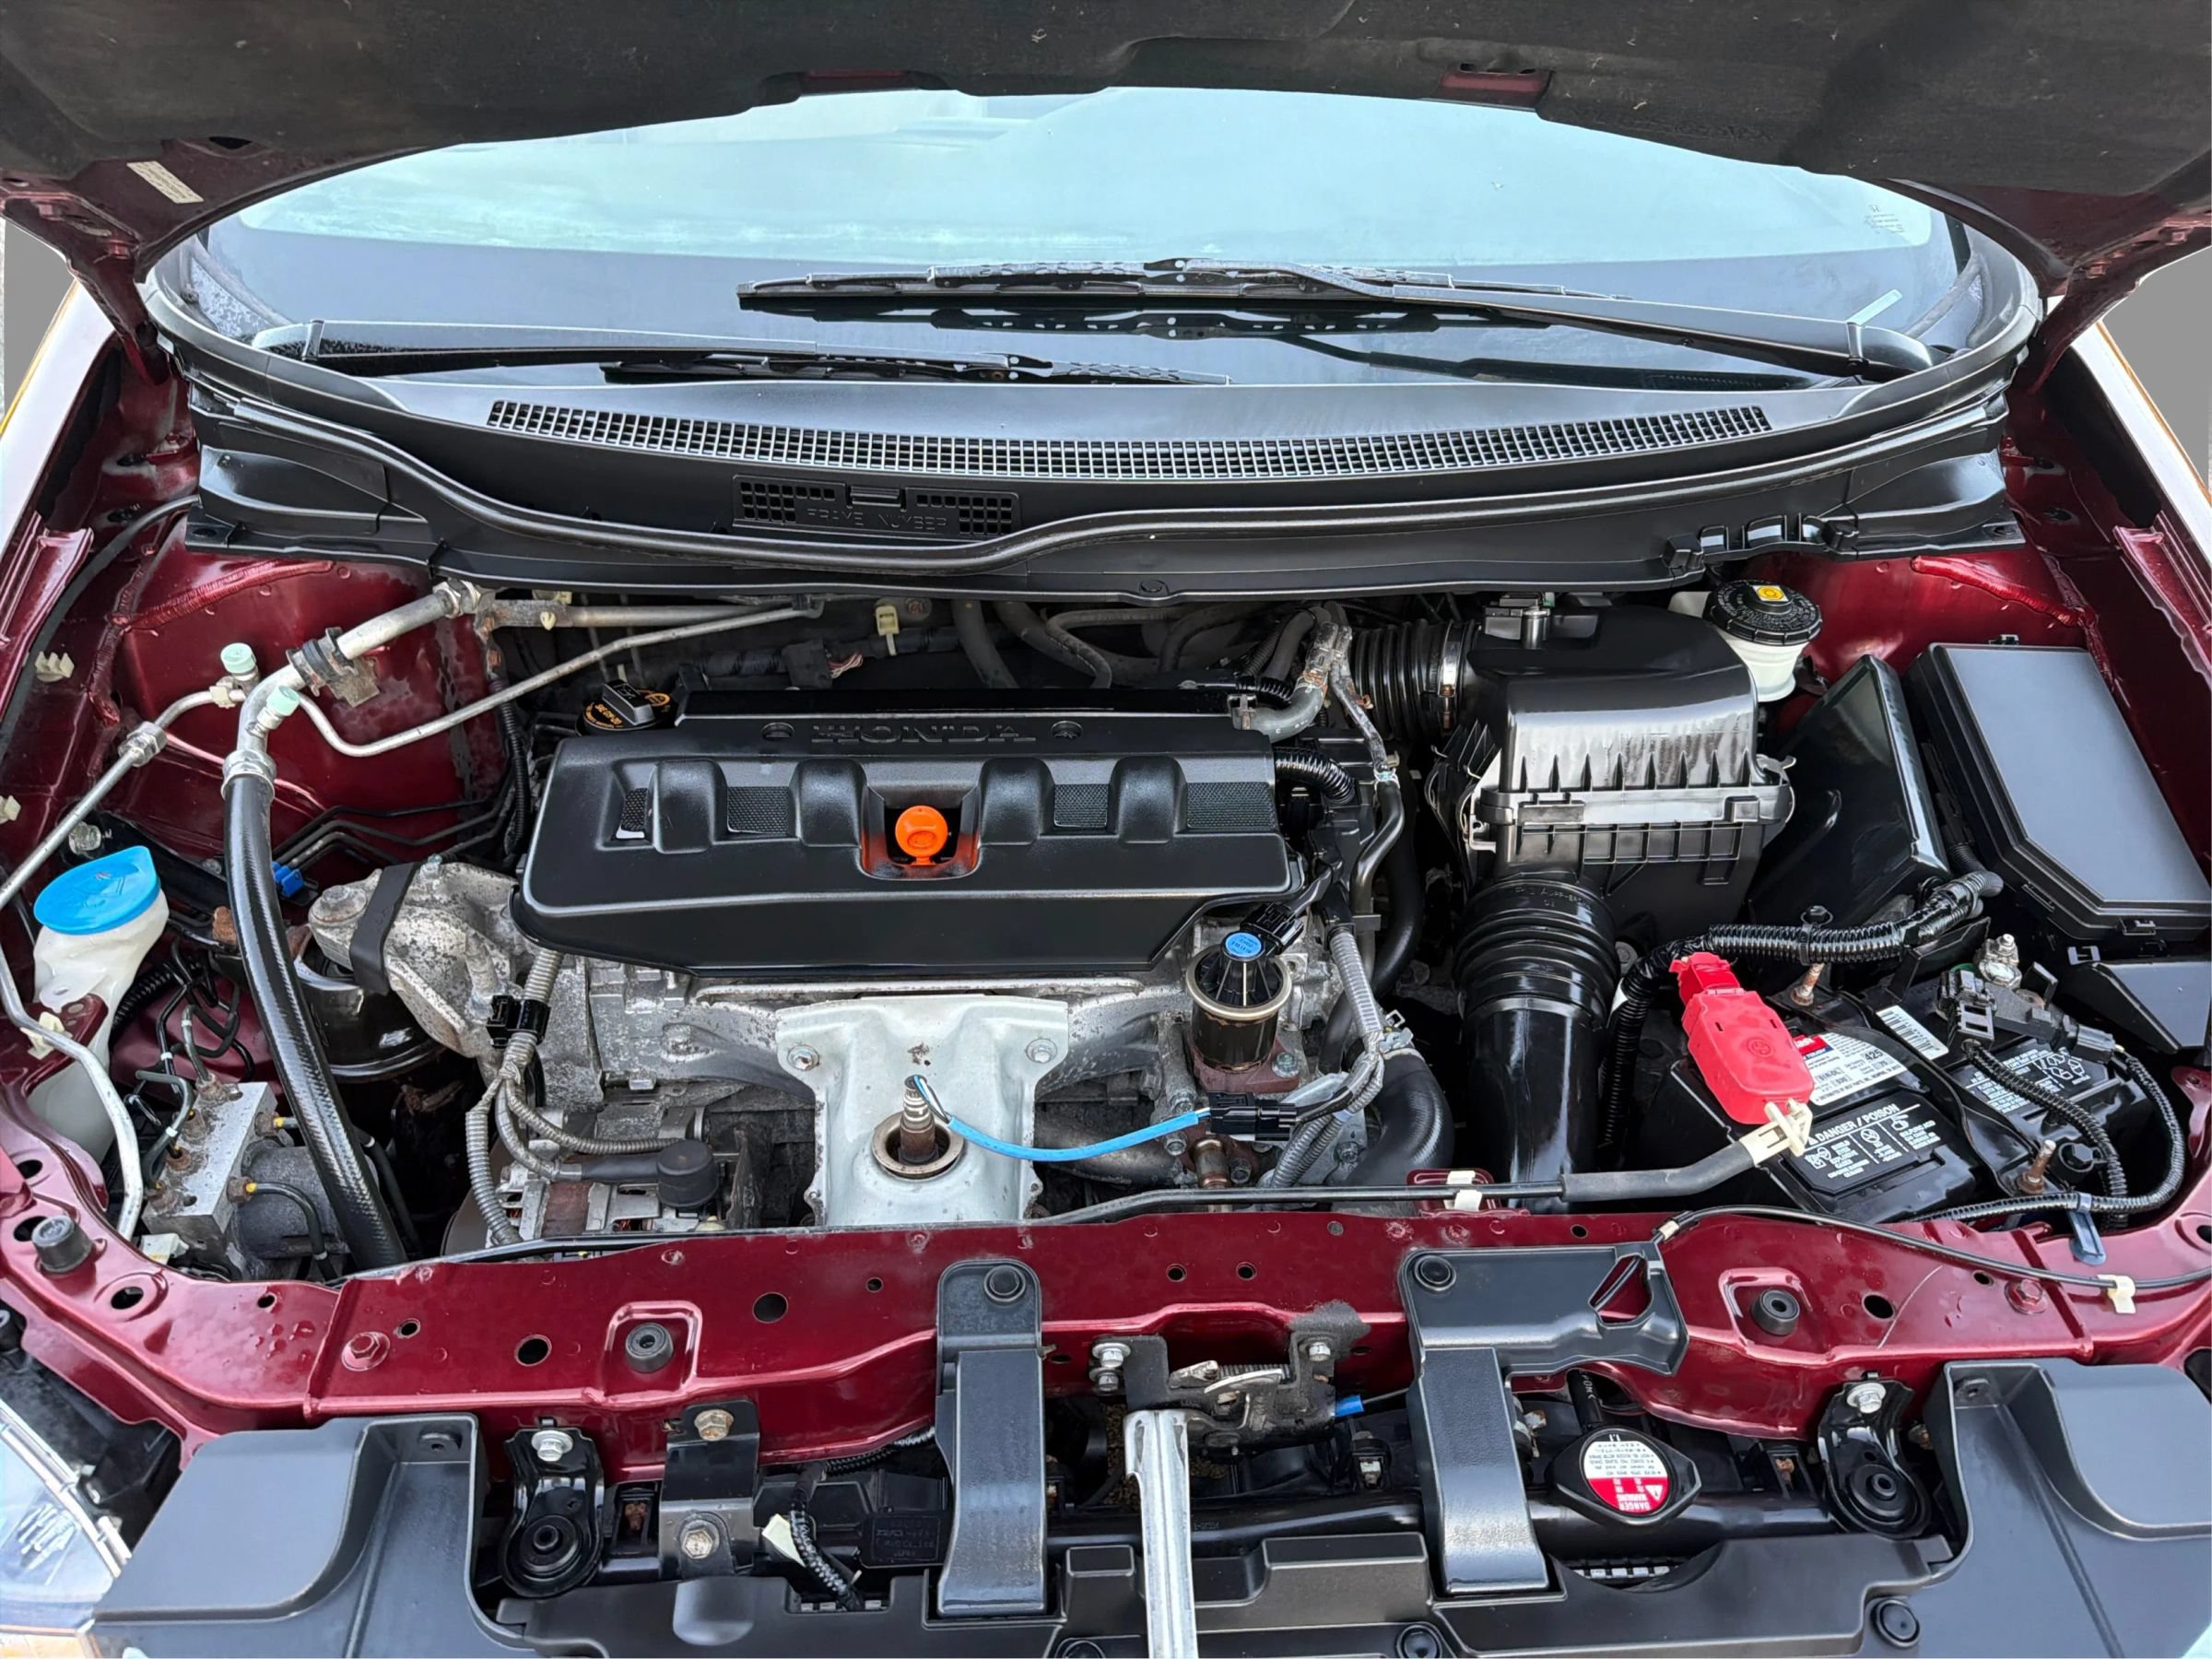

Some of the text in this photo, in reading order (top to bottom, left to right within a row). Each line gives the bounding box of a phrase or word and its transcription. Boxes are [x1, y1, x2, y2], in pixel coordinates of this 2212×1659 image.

[807, 509, 947, 531] FRAME NUMBER
[811, 724, 1036, 743] HONDA
[1864, 1049, 1884, 1061] 425
[1816, 1121, 1857, 1142] DANGER
[1863, 1104, 1900, 1124] POISON
[1618, 1501, 1651, 1512] DANGER
